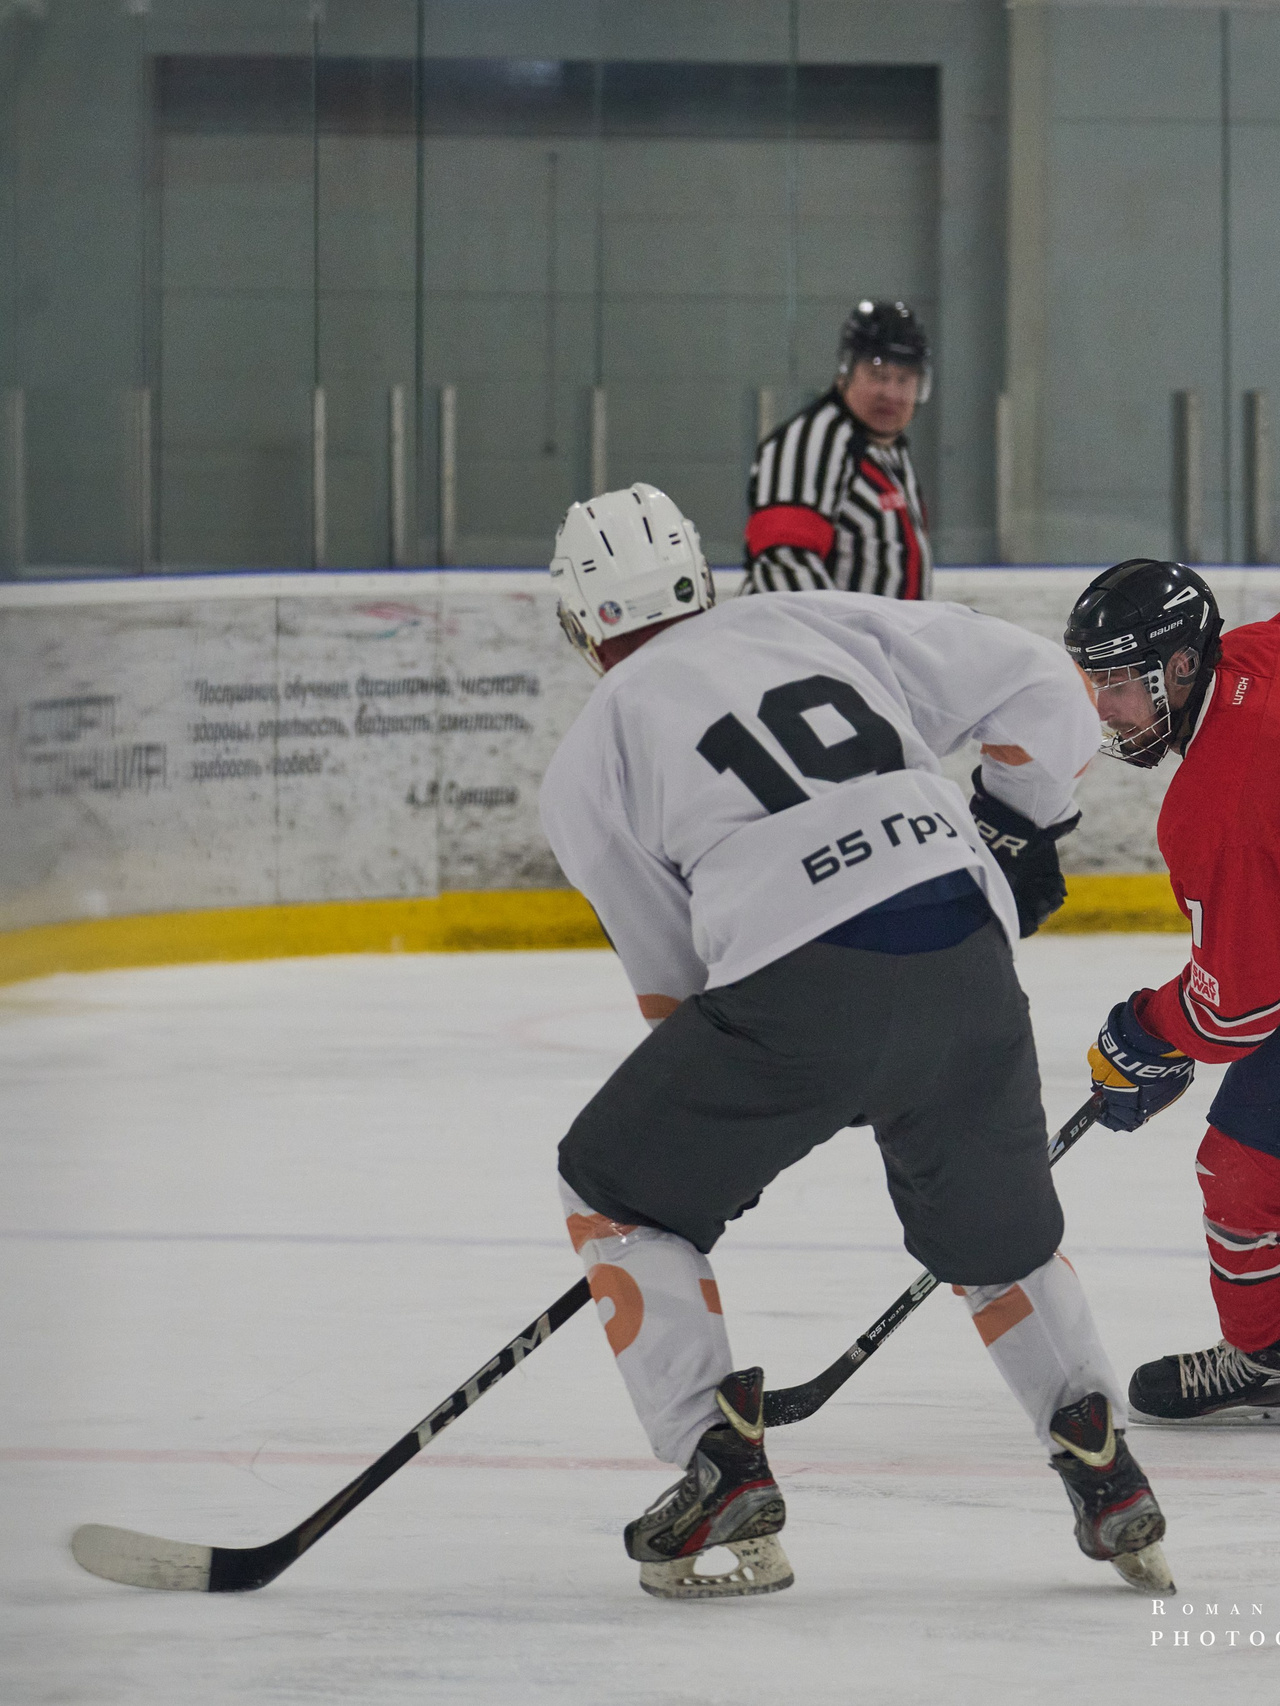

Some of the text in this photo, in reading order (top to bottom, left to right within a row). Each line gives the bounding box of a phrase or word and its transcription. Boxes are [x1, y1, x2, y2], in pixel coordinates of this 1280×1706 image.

[1149, 618, 1184, 639] BAUER
[1232, 676, 1250, 706] LUTCH
[880, 812, 958, 848] Гру
[1193, 964, 1216, 989] SILK
[1193, 975, 1217, 1001] WAY
[411, 1312, 552, 1450] CCM
